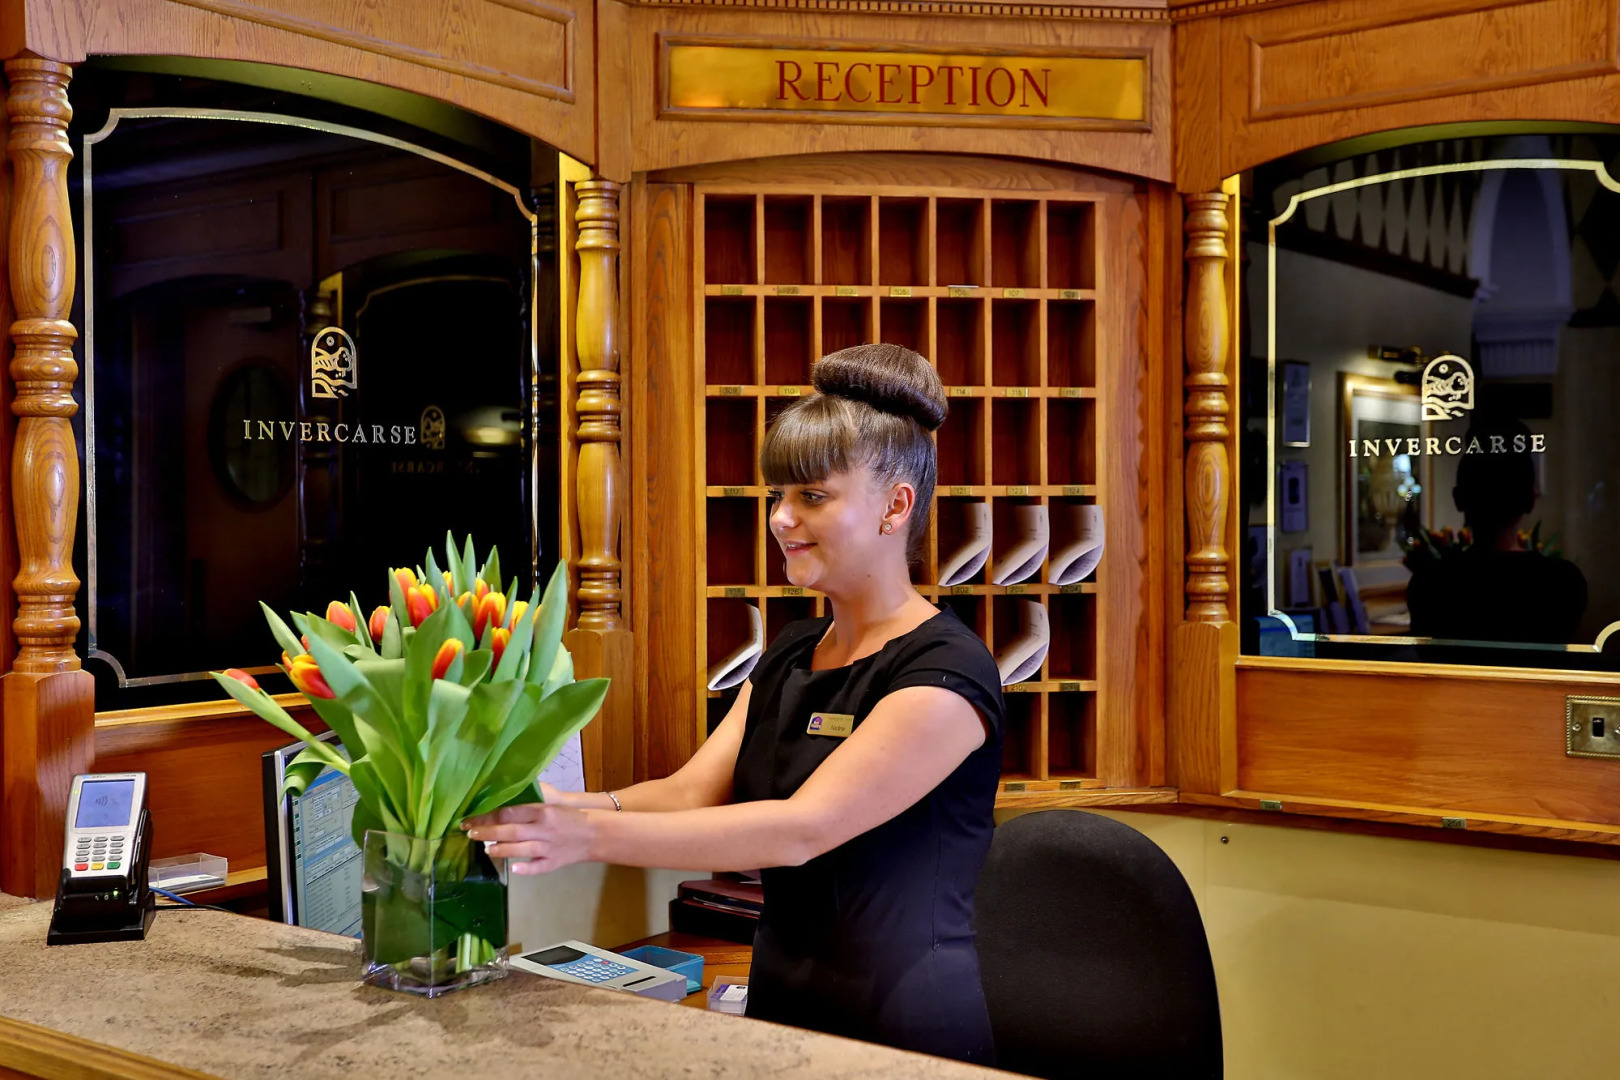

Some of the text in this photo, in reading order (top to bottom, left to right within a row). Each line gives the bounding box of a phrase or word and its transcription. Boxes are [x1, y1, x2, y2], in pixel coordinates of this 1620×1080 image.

[775, 60, 1052, 108] RECEPTION
[784, 387, 795, 395] 110
[956, 388, 966, 396] 114
[243, 419, 416, 445] INVERCARSE
[1349, 434, 1547, 457] INVERCARSE
